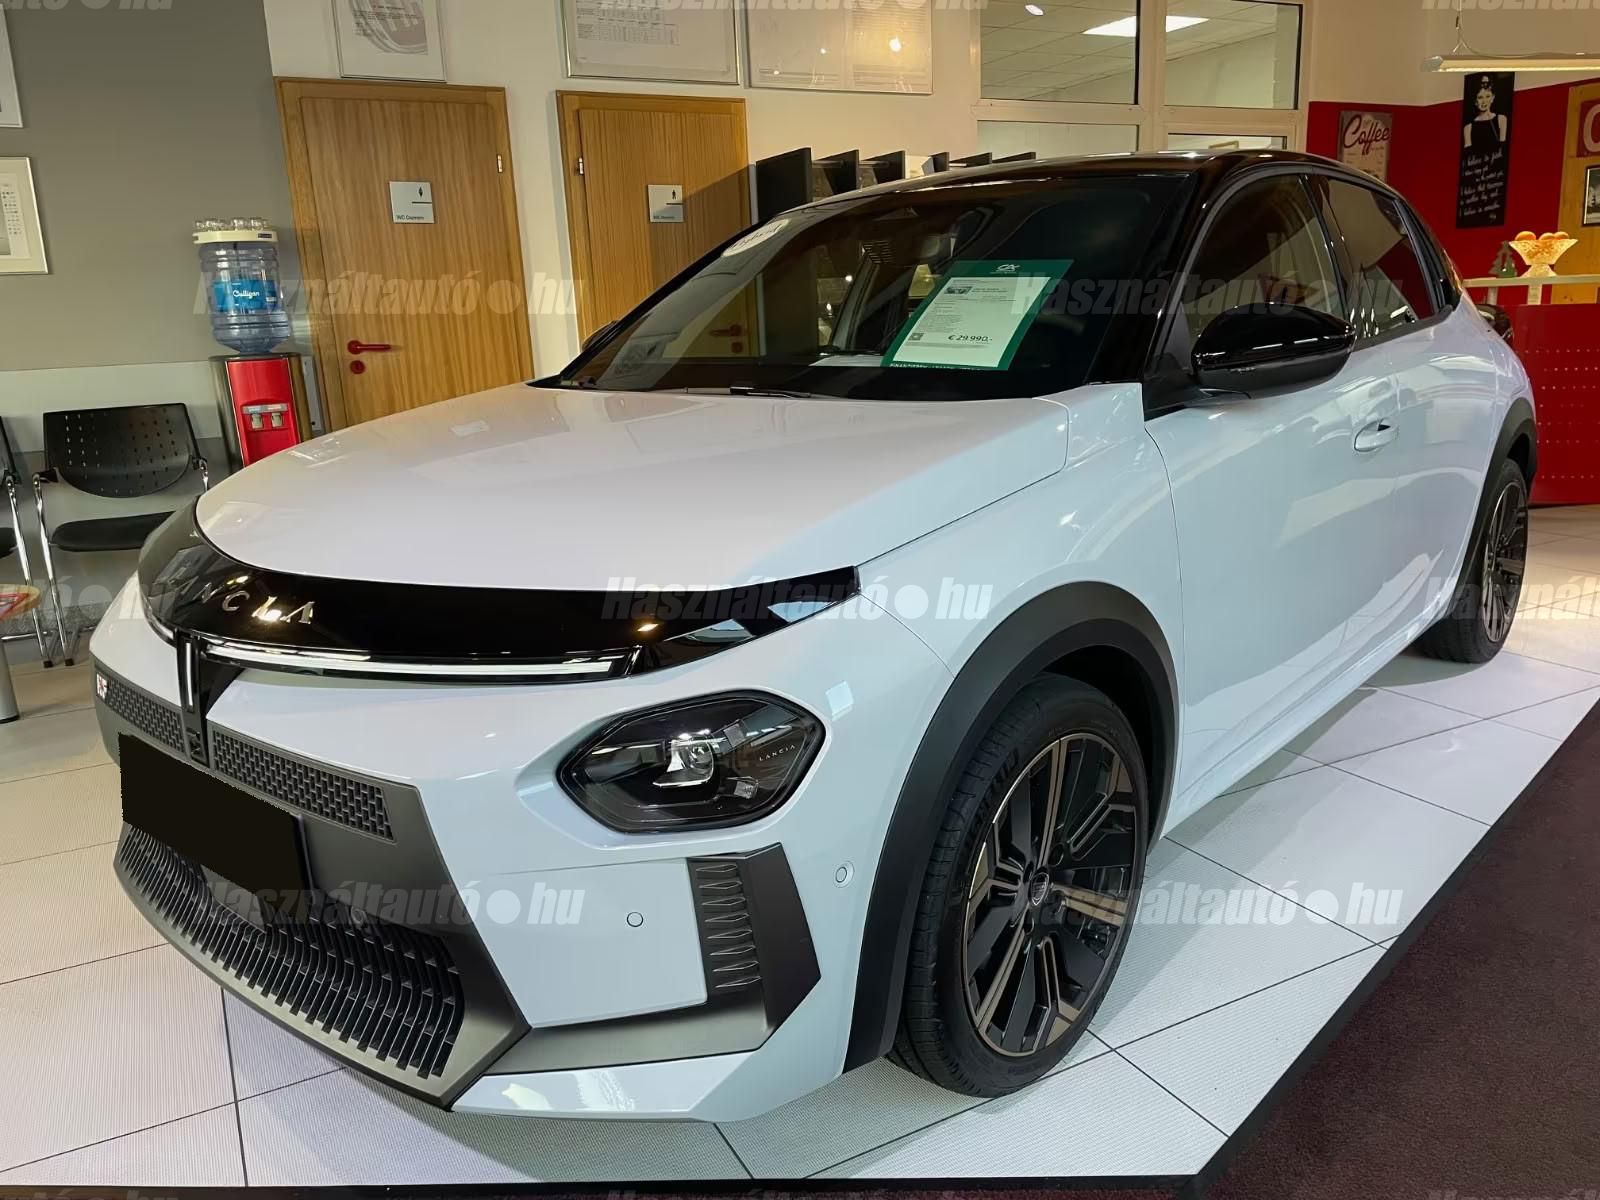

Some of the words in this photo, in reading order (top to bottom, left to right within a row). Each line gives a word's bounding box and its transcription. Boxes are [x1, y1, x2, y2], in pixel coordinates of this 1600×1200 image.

[1343, 114, 1390, 156] Coffee
[232, 289, 260, 299] Culligan
[759, 744, 796, 762] LANCIA
